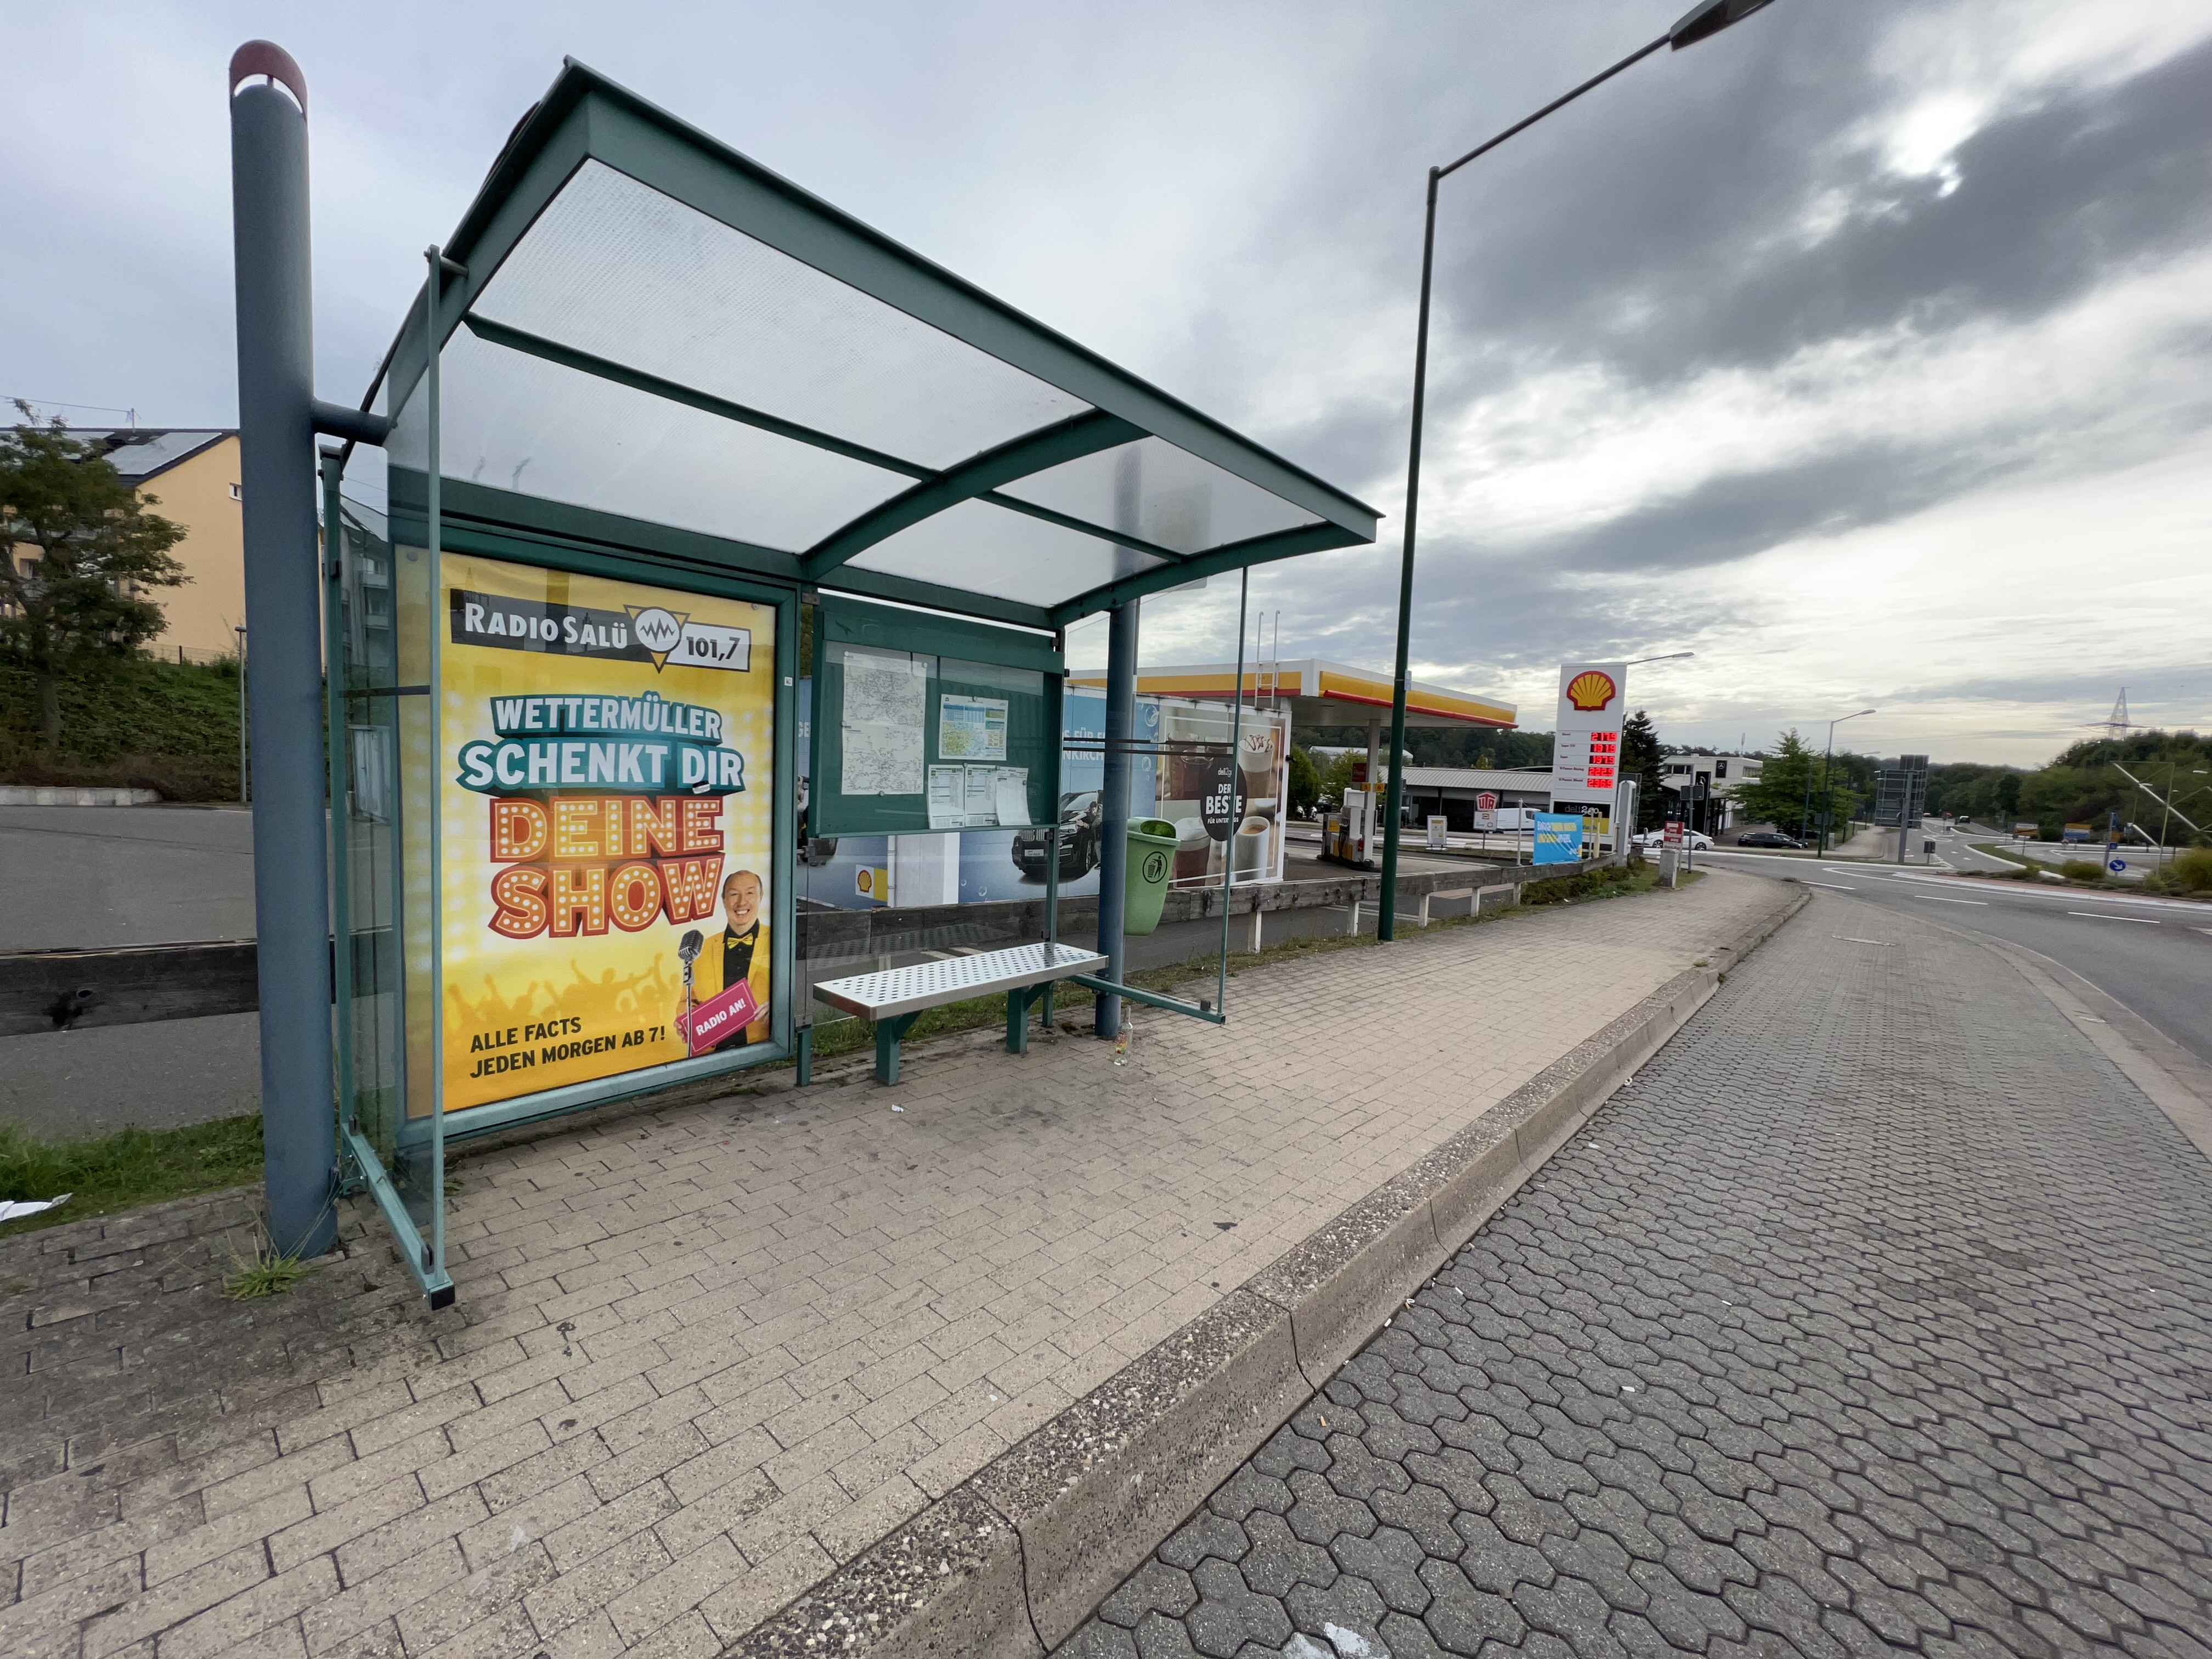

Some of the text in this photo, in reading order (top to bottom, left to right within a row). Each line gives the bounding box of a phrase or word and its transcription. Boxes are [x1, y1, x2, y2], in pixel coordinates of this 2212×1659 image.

[465, 602, 741, 662] RADIO SALÜ 101,7
[495, 693, 721, 740] WETTERMÜLLER
[1074, 727, 1093, 744] FÜR
[465, 742, 742, 787] SCHENKT DIR
[1218, 783, 1232, 794] DER
[1478, 792, 1496, 810] UTA
[494, 799, 721, 859] DEINE
[495, 857, 722, 934] SHOW
[470, 1016, 582, 1053] ALLE FACTS
[695, 997, 747, 1037] RADIO AN!
[469, 1052, 535, 1079] JEDEN
[542, 1034, 617, 1064] MORGEN
[622, 1029, 645, 1048] AB
